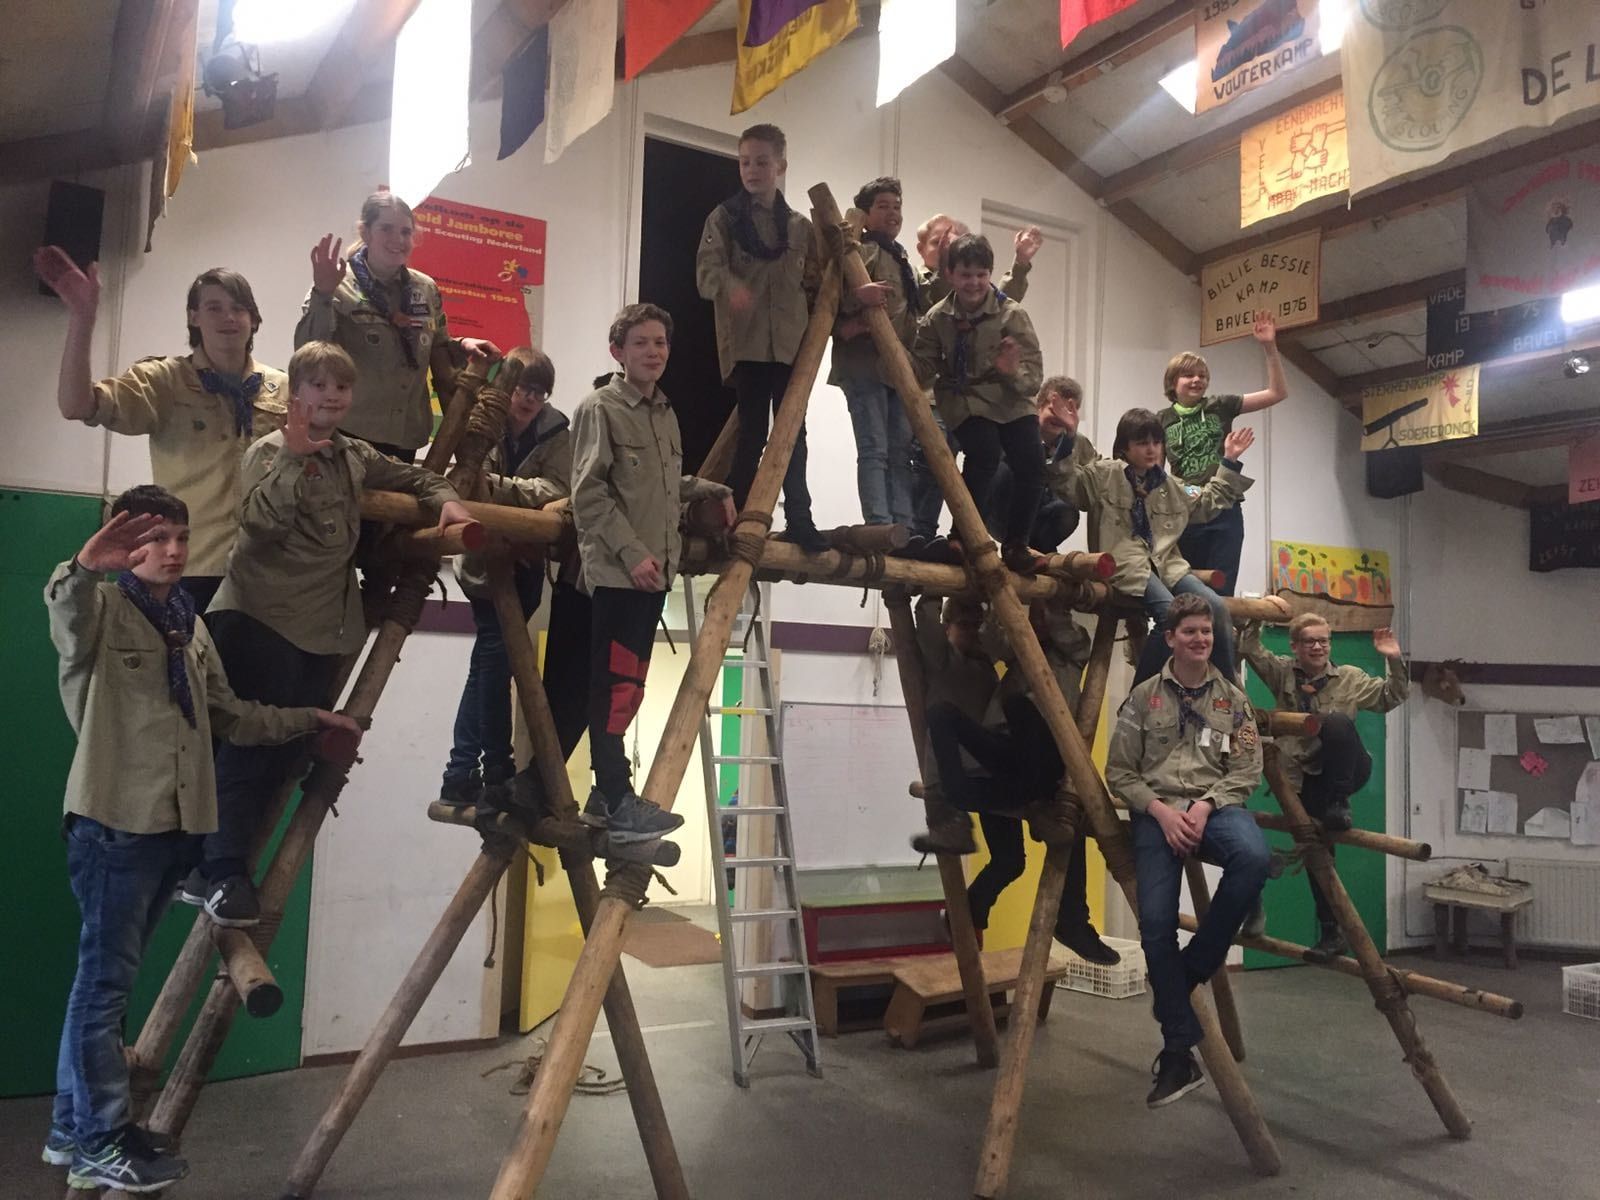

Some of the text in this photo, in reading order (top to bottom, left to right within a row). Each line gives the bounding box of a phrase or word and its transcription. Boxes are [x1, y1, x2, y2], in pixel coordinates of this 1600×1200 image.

[1521, 51, 1572, 106] DE
[434, 228, 483, 245] Scouting
[487, 238, 542, 255] Nederland
[446, 217, 523, 242] Jamboree
[1207, 253, 1311, 301] BILLIE BESSIE
[491, 294, 519, 304] 1995
[1236, 280, 1279, 303] KAMP
[1279, 296, 1307, 318] 1976
[1427, 349, 1464, 369] KAMP
